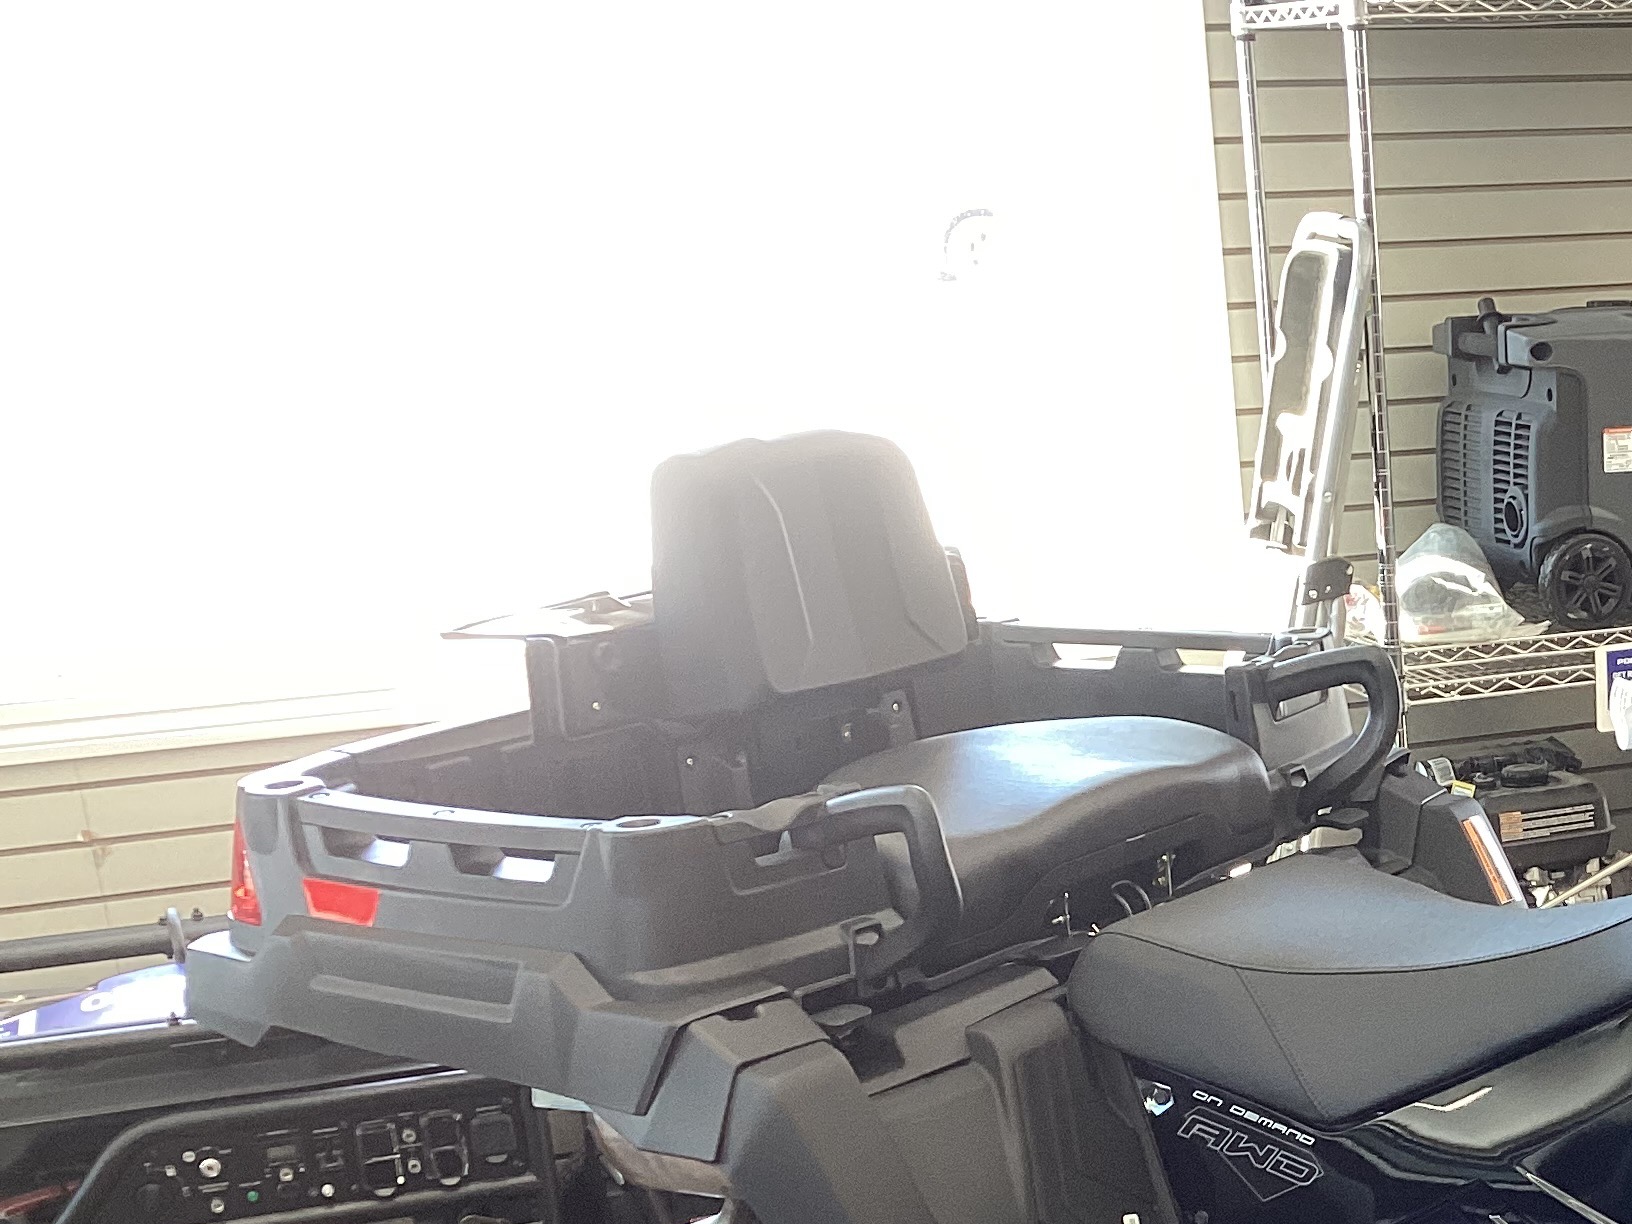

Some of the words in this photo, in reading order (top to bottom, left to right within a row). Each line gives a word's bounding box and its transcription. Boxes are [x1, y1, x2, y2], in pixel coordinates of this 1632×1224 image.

[1192, 1089, 1224, 1107] ON
[1229, 1104, 1316, 1146] DEMAND
[1177, 1115, 1319, 1186] AWD
